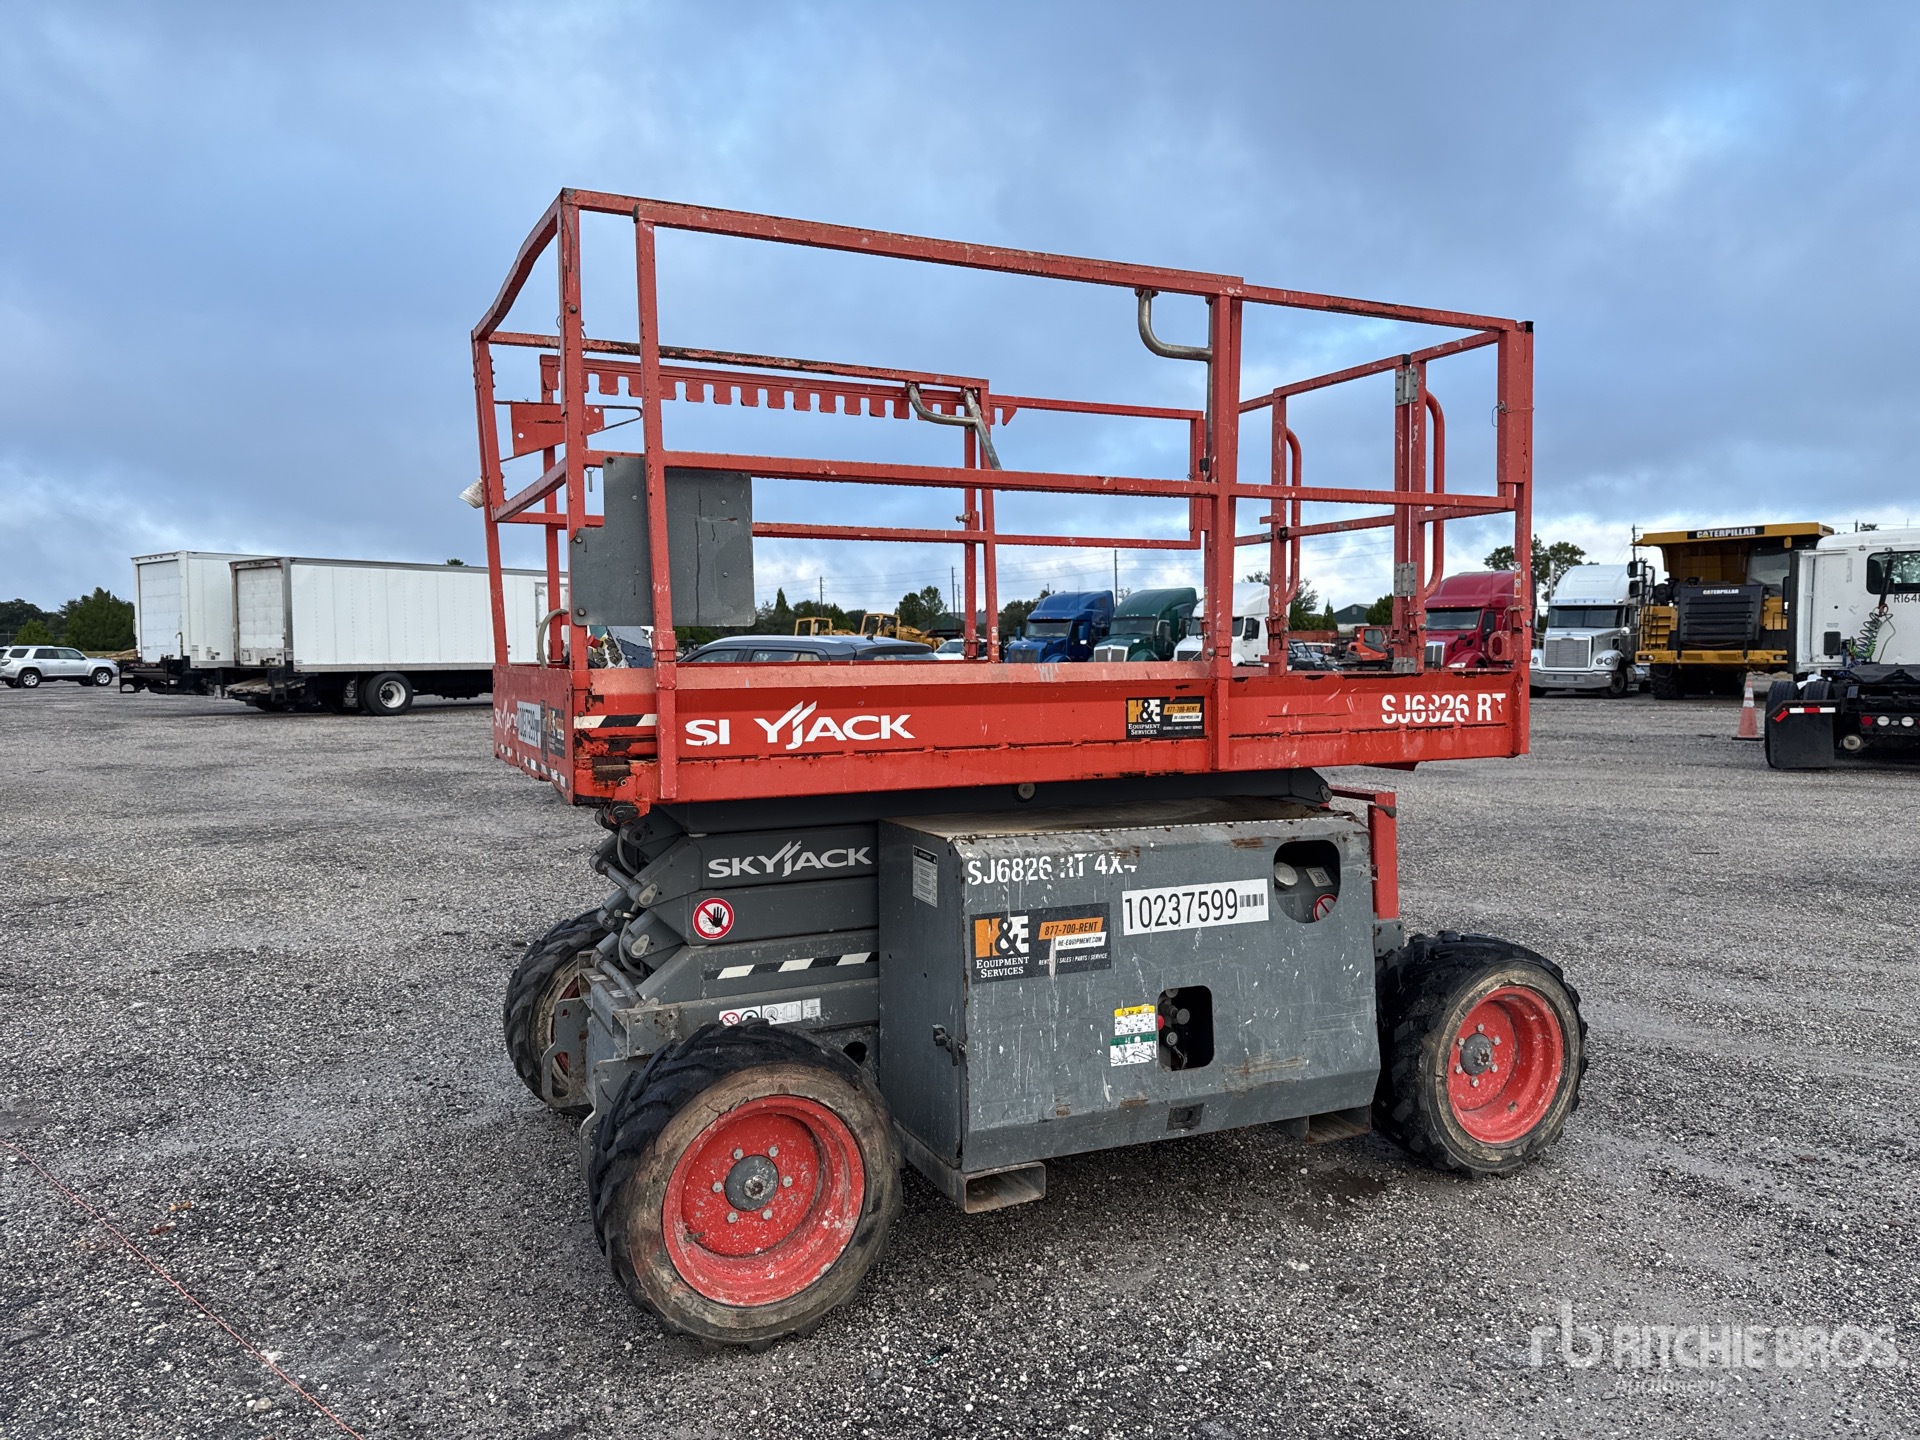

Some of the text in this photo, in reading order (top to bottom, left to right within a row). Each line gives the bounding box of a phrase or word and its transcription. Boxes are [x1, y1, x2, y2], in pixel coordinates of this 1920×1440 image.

[1696, 527, 1756, 539] CATERPILLAR
[1702, 588, 1740, 596] CATERPILLAR
[1127, 699, 1161, 723] H&E
[1381, 693, 1470, 725] SJ6826
[708, 840, 873, 879] SKYJACK
[966, 855, 1054, 886] SJ6826
[1124, 888, 1238, 930] 10237599
[974, 915, 1030, 958] H&E
[1044, 921, 1099, 936] 877-700-RENT
[975, 956, 1030, 969] EQUIPMENT
[980, 966, 1024, 979] SERVICES
